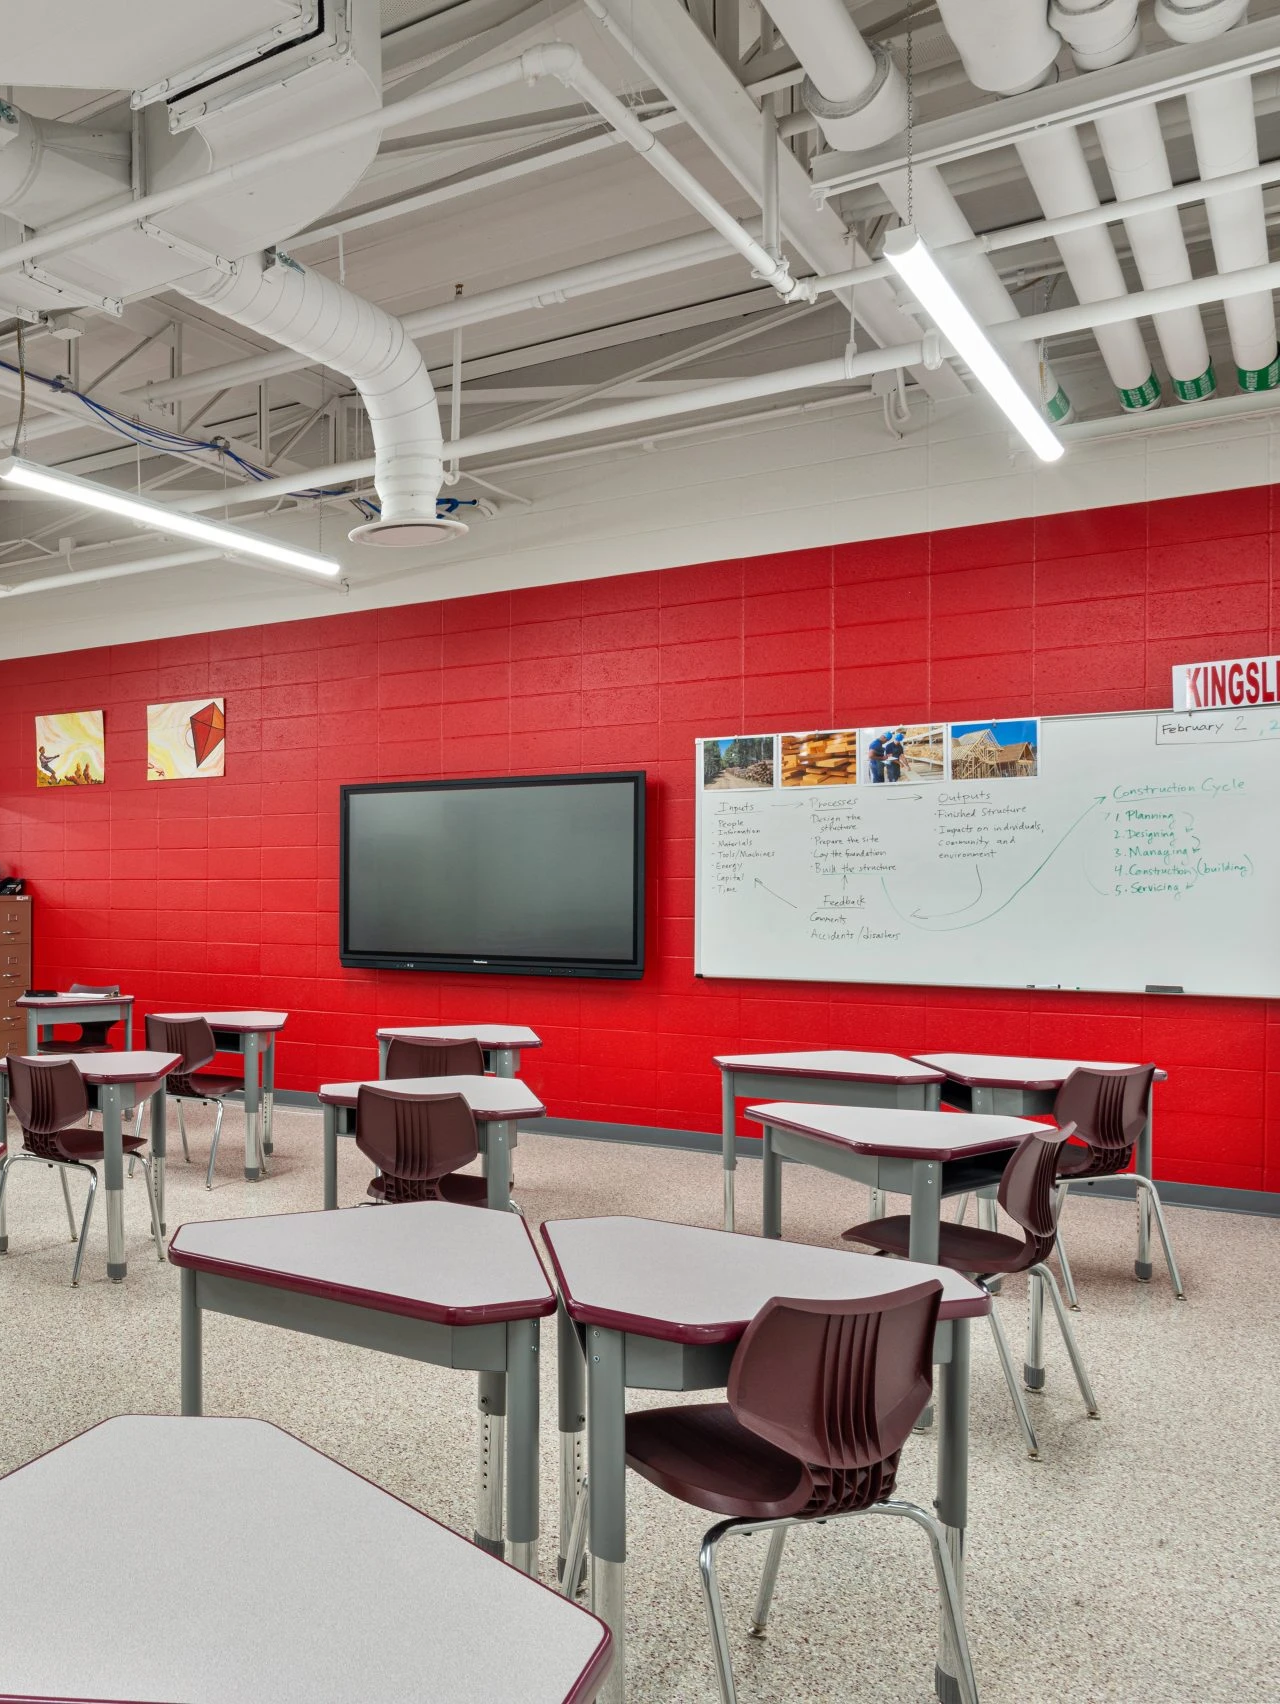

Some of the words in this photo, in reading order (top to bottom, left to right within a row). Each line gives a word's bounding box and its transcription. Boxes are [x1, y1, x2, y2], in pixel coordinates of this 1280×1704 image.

[1186, 661, 1280, 708] KINGSL
[1162, 723, 1224, 735] February
[1113, 782, 1196, 800] Construction
[1201, 777, 1245, 799] Cycle
[809, 797, 858, 808] Processes
[938, 791, 992, 804] Outputs
[718, 801, 754, 814] Inputs
[937, 808, 976, 818] Finished
[1125, 809, 1175, 829] Planning
[938, 824, 973, 837] Impacts
[1127, 828, 1176, 846] Designing
[996, 836, 1016, 844] and
[938, 850, 998, 859] environment
[1128, 846, 1188, 865] Managing
[1130, 881, 1181, 901] Servicing
[824, 895, 866, 906] Feedback
